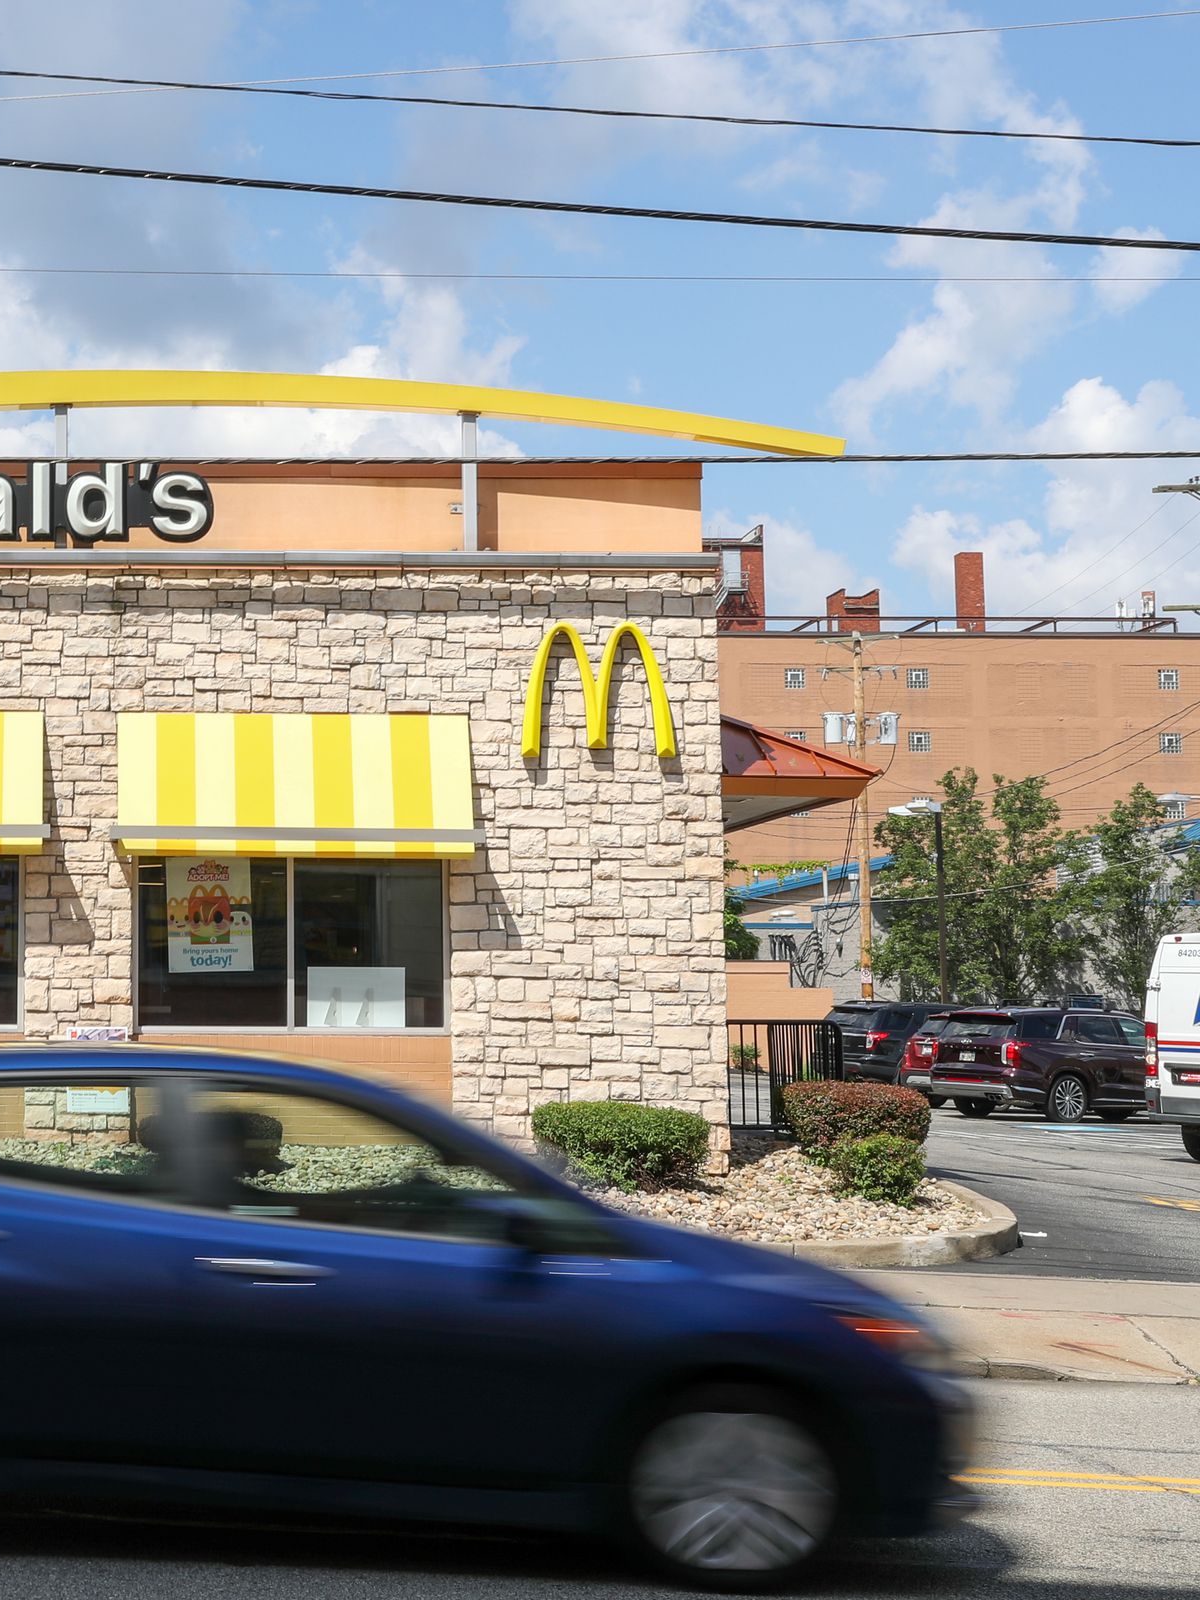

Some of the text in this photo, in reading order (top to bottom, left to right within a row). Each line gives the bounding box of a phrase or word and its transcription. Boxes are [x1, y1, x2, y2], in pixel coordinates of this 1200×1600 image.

[187, 873, 213, 882] ADOPT
[201, 948, 219, 956] yours
[190, 954, 232, 968] today!
